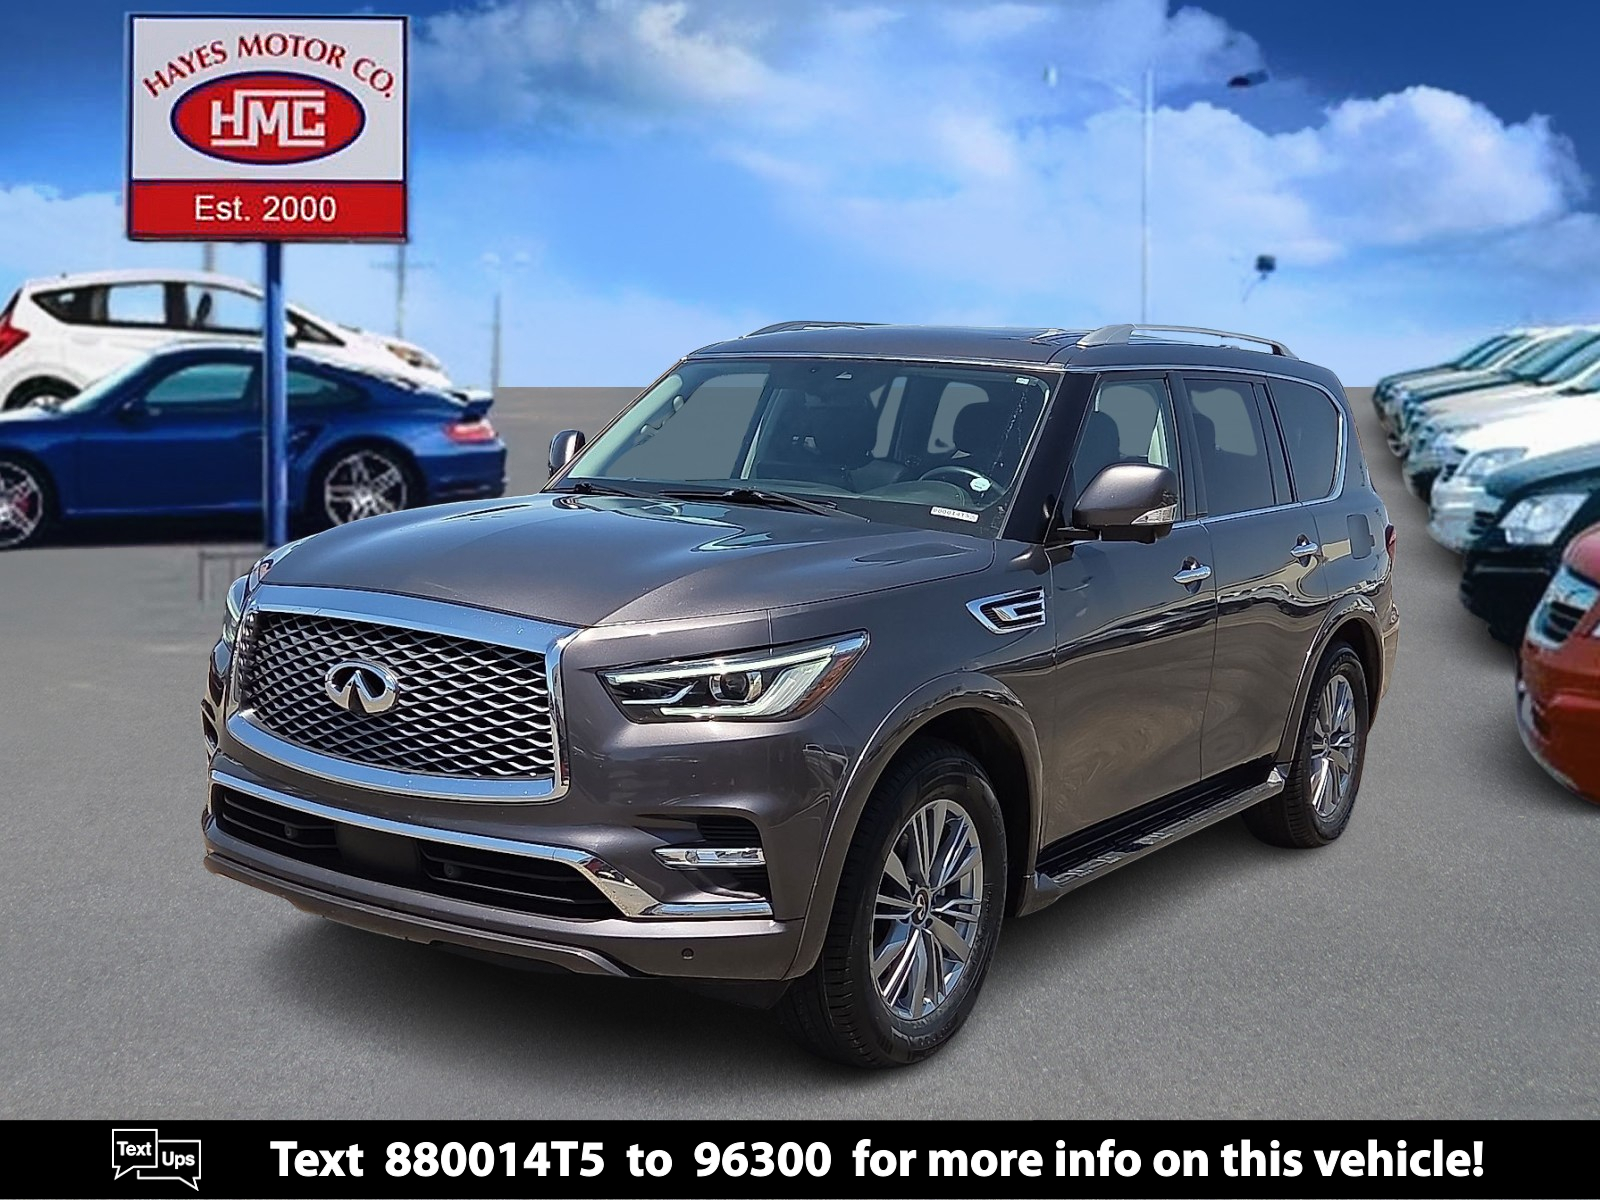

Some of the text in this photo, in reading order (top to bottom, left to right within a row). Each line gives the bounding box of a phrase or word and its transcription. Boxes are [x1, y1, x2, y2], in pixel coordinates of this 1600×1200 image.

[142, 32, 396, 98] HAYES MOTOR CO.
[210, 89, 326, 147] HMC
[195, 195, 337, 222] Est. 2000
